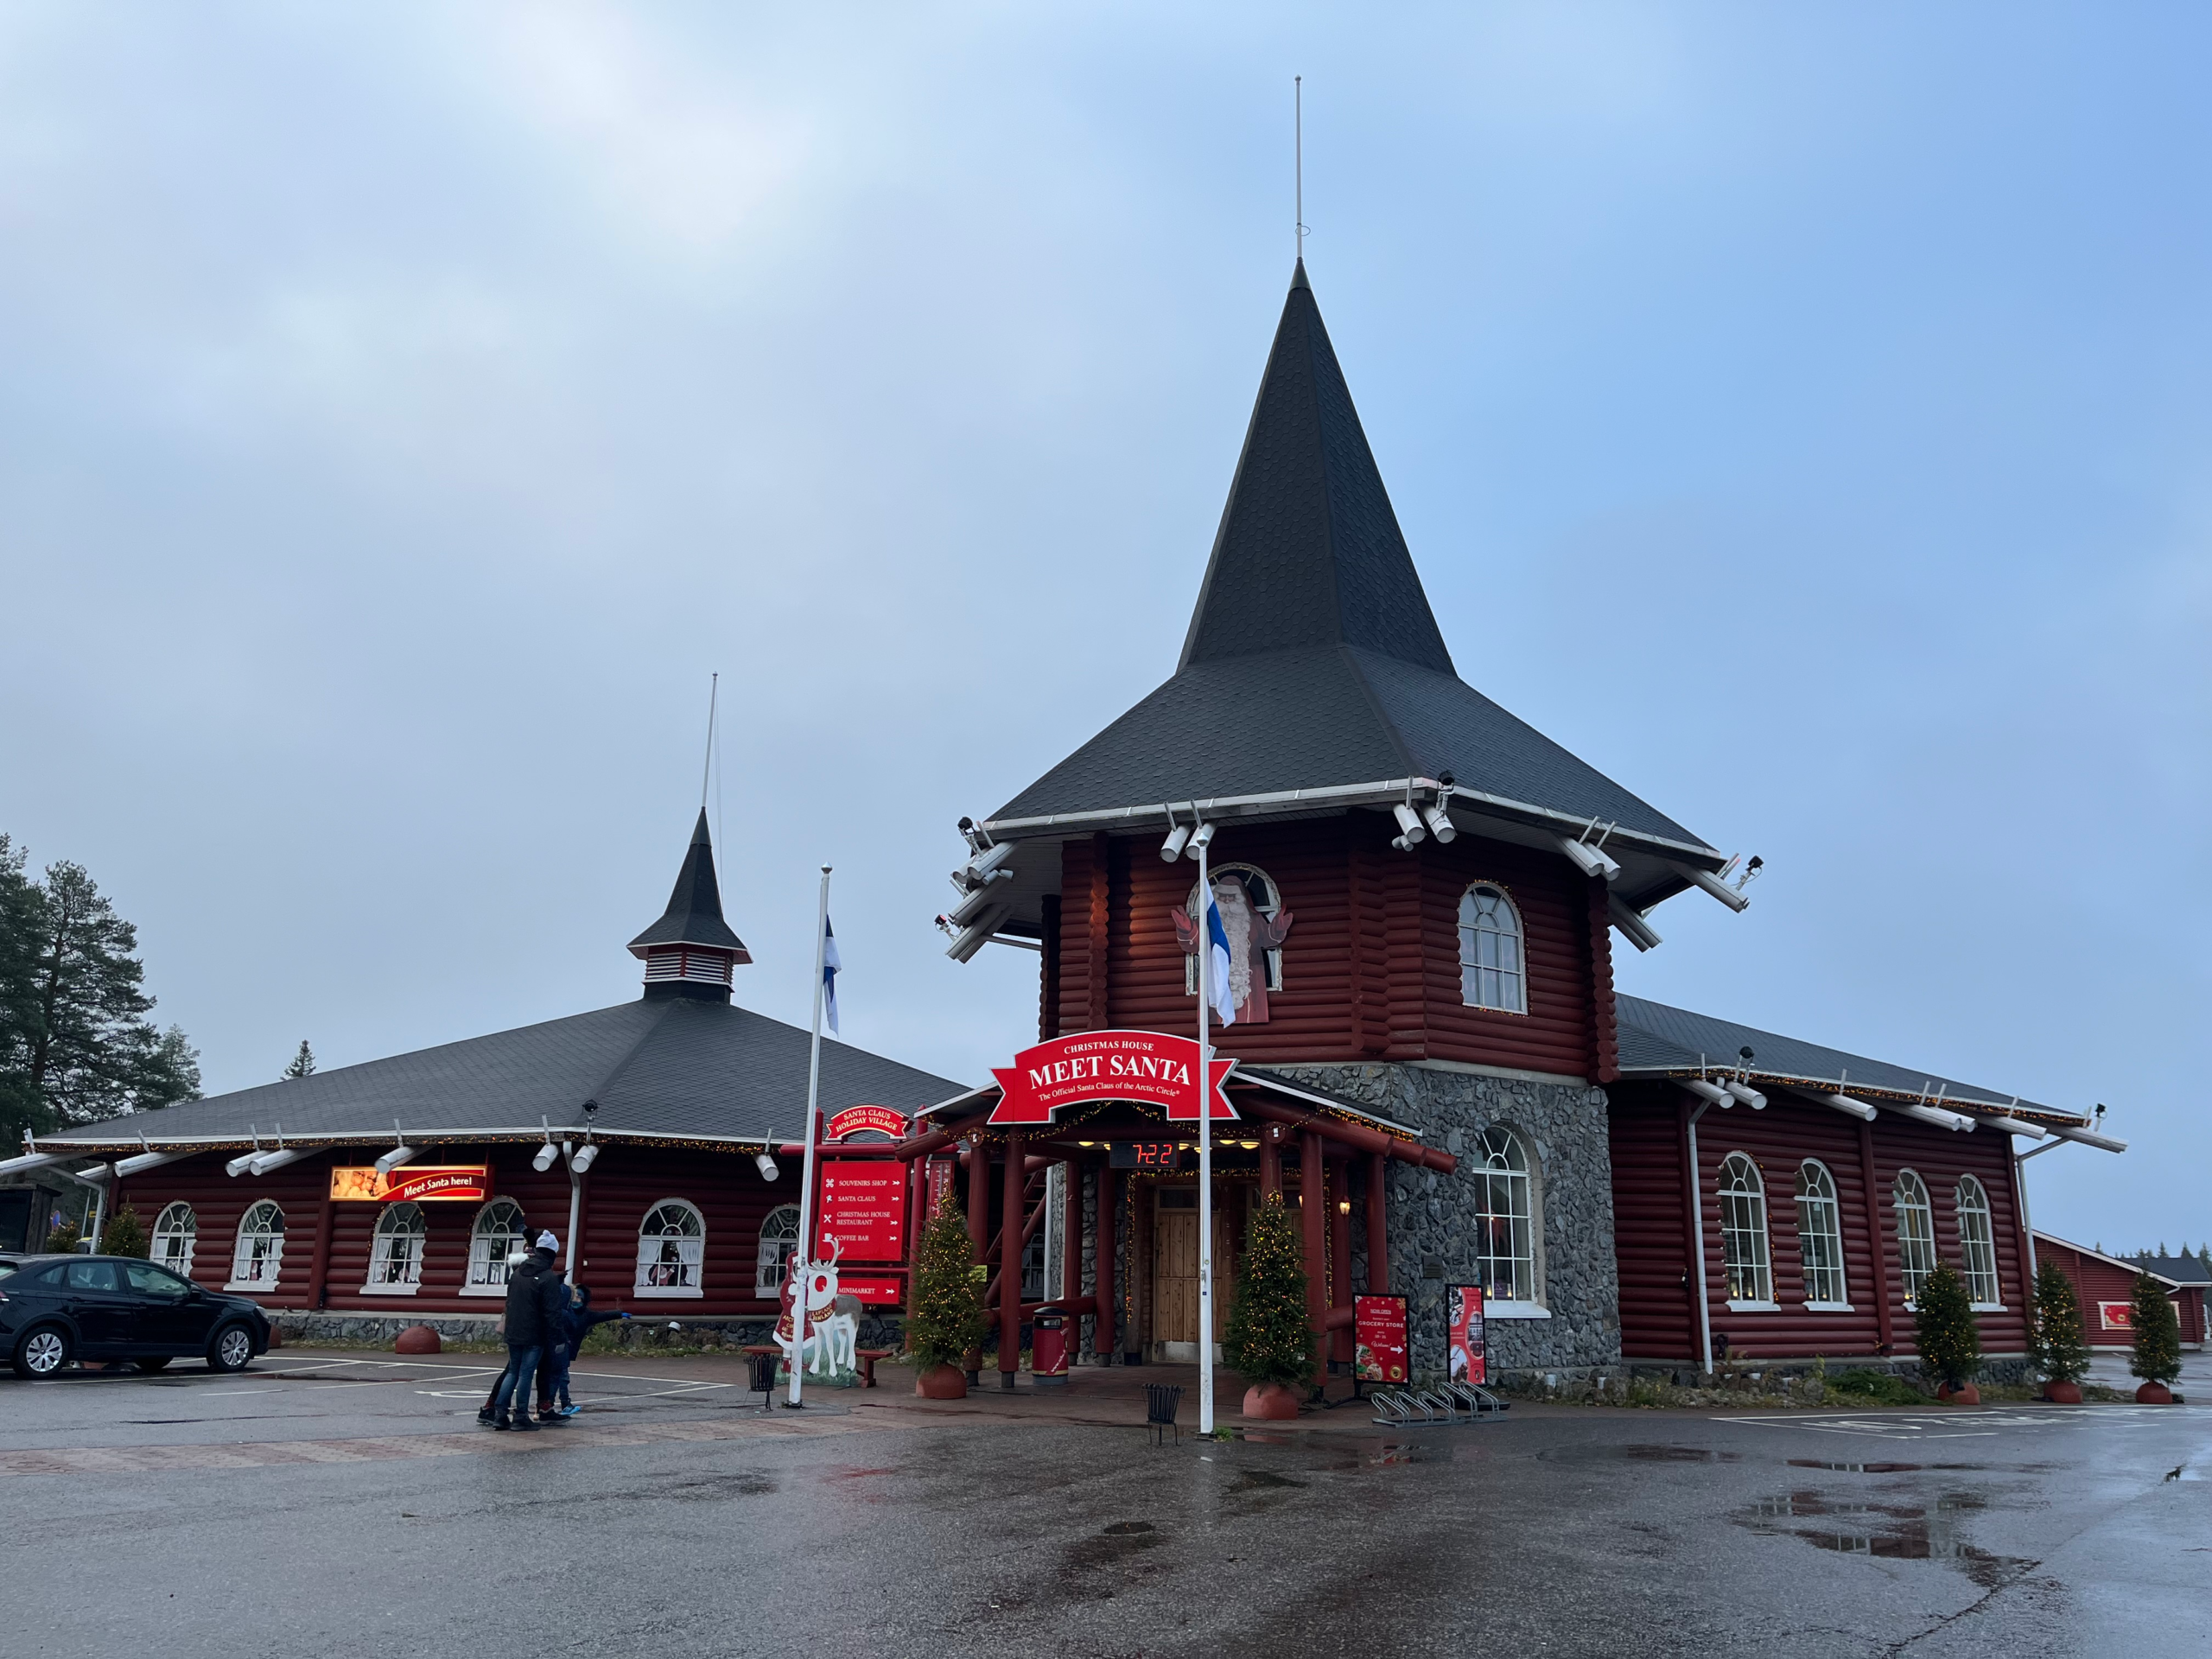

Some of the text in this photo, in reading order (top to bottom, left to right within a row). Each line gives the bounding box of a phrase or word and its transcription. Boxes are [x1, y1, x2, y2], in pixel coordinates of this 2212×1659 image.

[1064, 1040, 1154, 1055] CHRISTMAS HOUSE
[1027, 1054, 1191, 1090] MEET SANTA
[1038, 1093, 1051, 1102] The
[1052, 1086, 1076, 1097] Official
[1077, 1084, 1095, 1092] Santa
[1096, 1082, 1115, 1090] Claus
[1115, 1081, 1123, 1090] of
[1135, 1083, 1155, 1092] Arctic
[836, 1116, 898, 1133] HOLIDAY VILLAGE
[843, 1109, 891, 1121] SANTA CLAUS
[404, 1176, 472, 1198] Meet Santa here!
